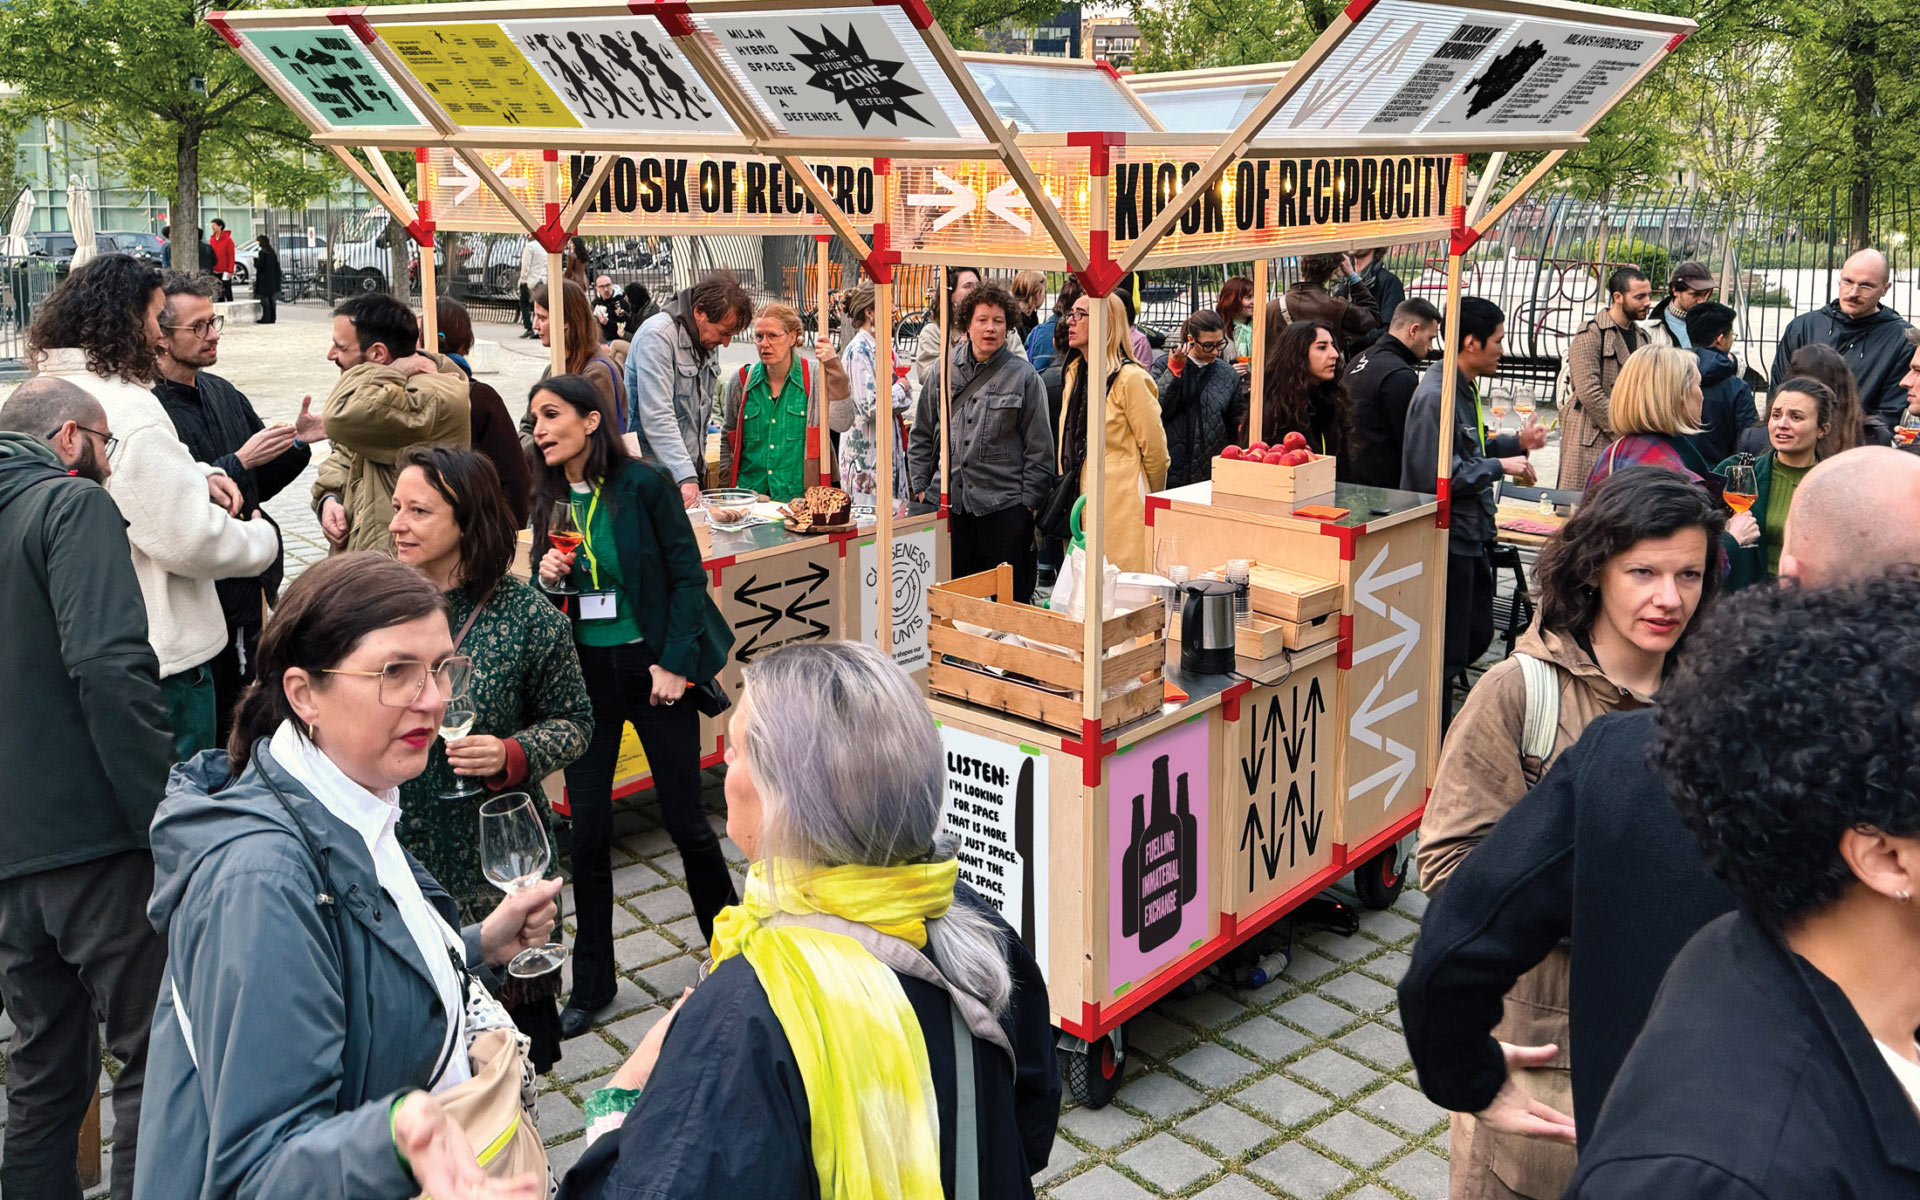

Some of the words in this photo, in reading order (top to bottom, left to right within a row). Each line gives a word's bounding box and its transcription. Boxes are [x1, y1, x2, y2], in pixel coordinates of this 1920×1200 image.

[726, 29, 766, 39] MILAN
[1449, 24, 1474, 41] THE
[1461, 25, 1495, 43] KIOSK
[1563, 33, 1597, 47] MILAN'S
[1591, 36, 1620, 49] HYBRID
[1615, 38, 1644, 51] SPACES
[315, 37, 352, 50] WOULD
[735, 45, 779, 55] HYBRID
[1432, 41, 1487, 60] RECIPROCITY
[341, 57, 363, 70] YOU
[814, 60, 852, 73] FUTURE
[850, 54, 863, 63] IS
[819, 49, 840, 60] THE
[747, 62, 796, 72] SPACES
[824, 79, 834, 87] A
[831, 64, 889, 91] ZONE
[765, 85, 798, 95] ZONE
[865, 87, 880, 95] TO
[779, 99, 789, 107] A
[855, 97, 894, 107] DEFEND
[783, 112, 843, 122] DEFENDRE
[700, 161, 737, 214] OF
[1236, 160, 1270, 231] OF
[1278, 157, 1453, 228] RECIPROCITY
[947, 751, 1009, 787] LISTEN:
[949, 779, 962, 793] I'M
[964, 783, 1003, 805] LOOKING
[953, 798, 970, 813] FOR
[972, 804, 999, 822] SPACE
[947, 813, 970, 830] THAT
[972, 821, 981, 833] IS
[983, 825, 1007, 842] MORE
[964, 836, 986, 853] JUST
[988, 845, 1018, 865] SPACE.
[1145, 829, 1175, 866] FUELLING
[956, 852, 984, 869] WANT
[986, 861, 1004, 877] THE
[957, 868, 974, 883] EAL
[975, 874, 1005, 896] SPACE,
[1142, 858, 1179, 899] IMMATERIAL
[1144, 888, 1177, 928] EXCHANGE
